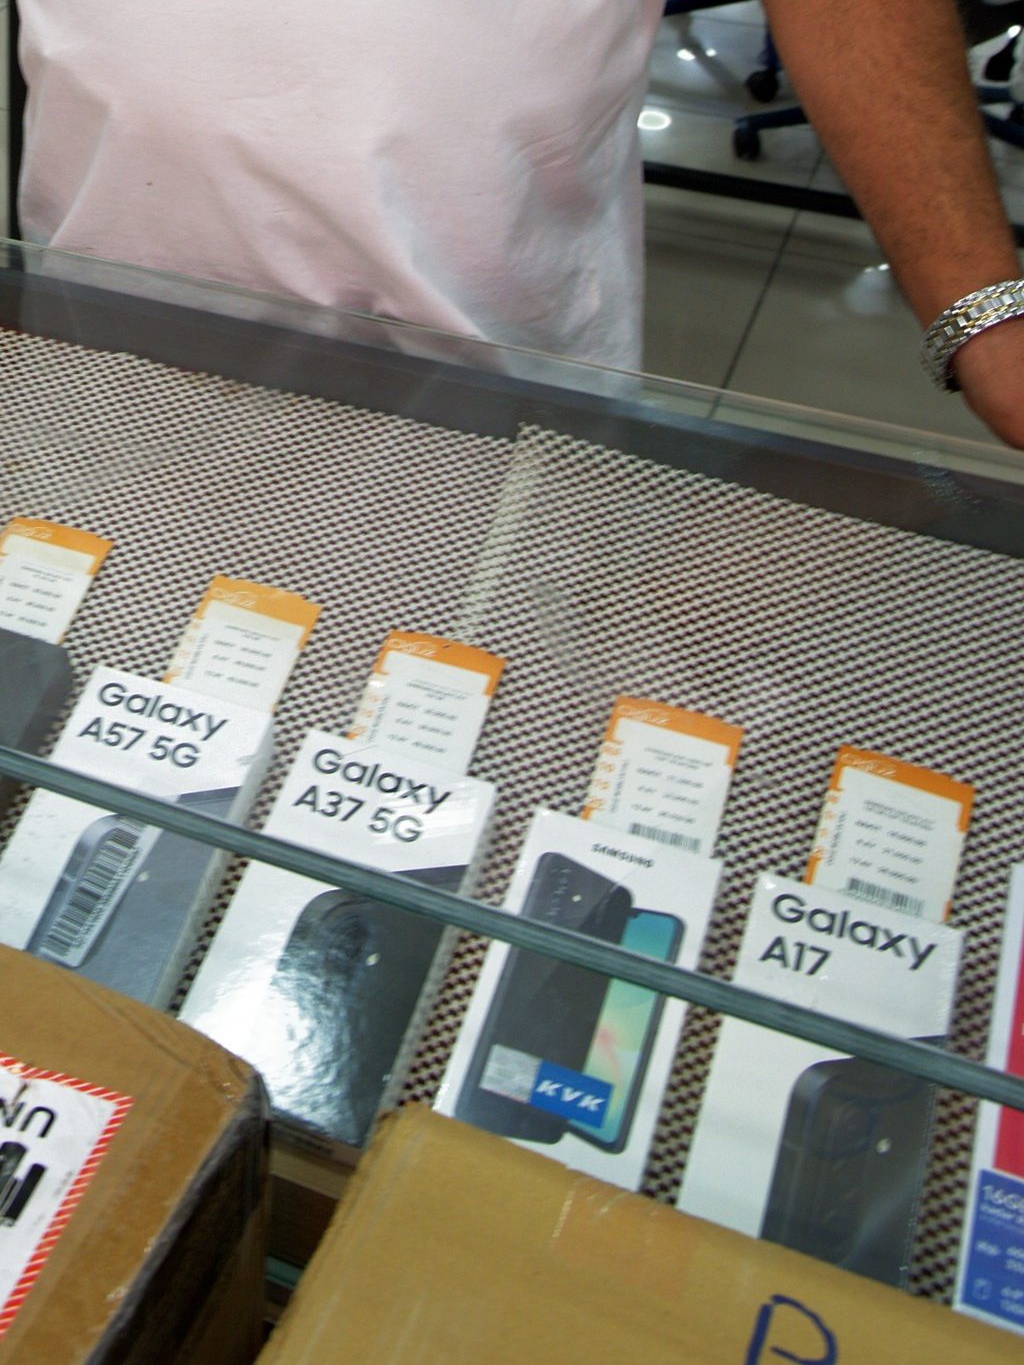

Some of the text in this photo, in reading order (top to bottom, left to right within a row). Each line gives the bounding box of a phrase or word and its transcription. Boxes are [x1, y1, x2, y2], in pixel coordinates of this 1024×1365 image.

[98, 681, 230, 741] Galaxy
[78, 716, 201, 769] A57 5G
[313, 748, 452, 815] Galaxy
[292, 785, 424, 843] A37 5G
[591, 842, 654, 868] SAMSUNG
[759, 935, 833, 978] A17
[771, 891, 937, 972] Galaxy
[535, 1079, 607, 1113] KVK
